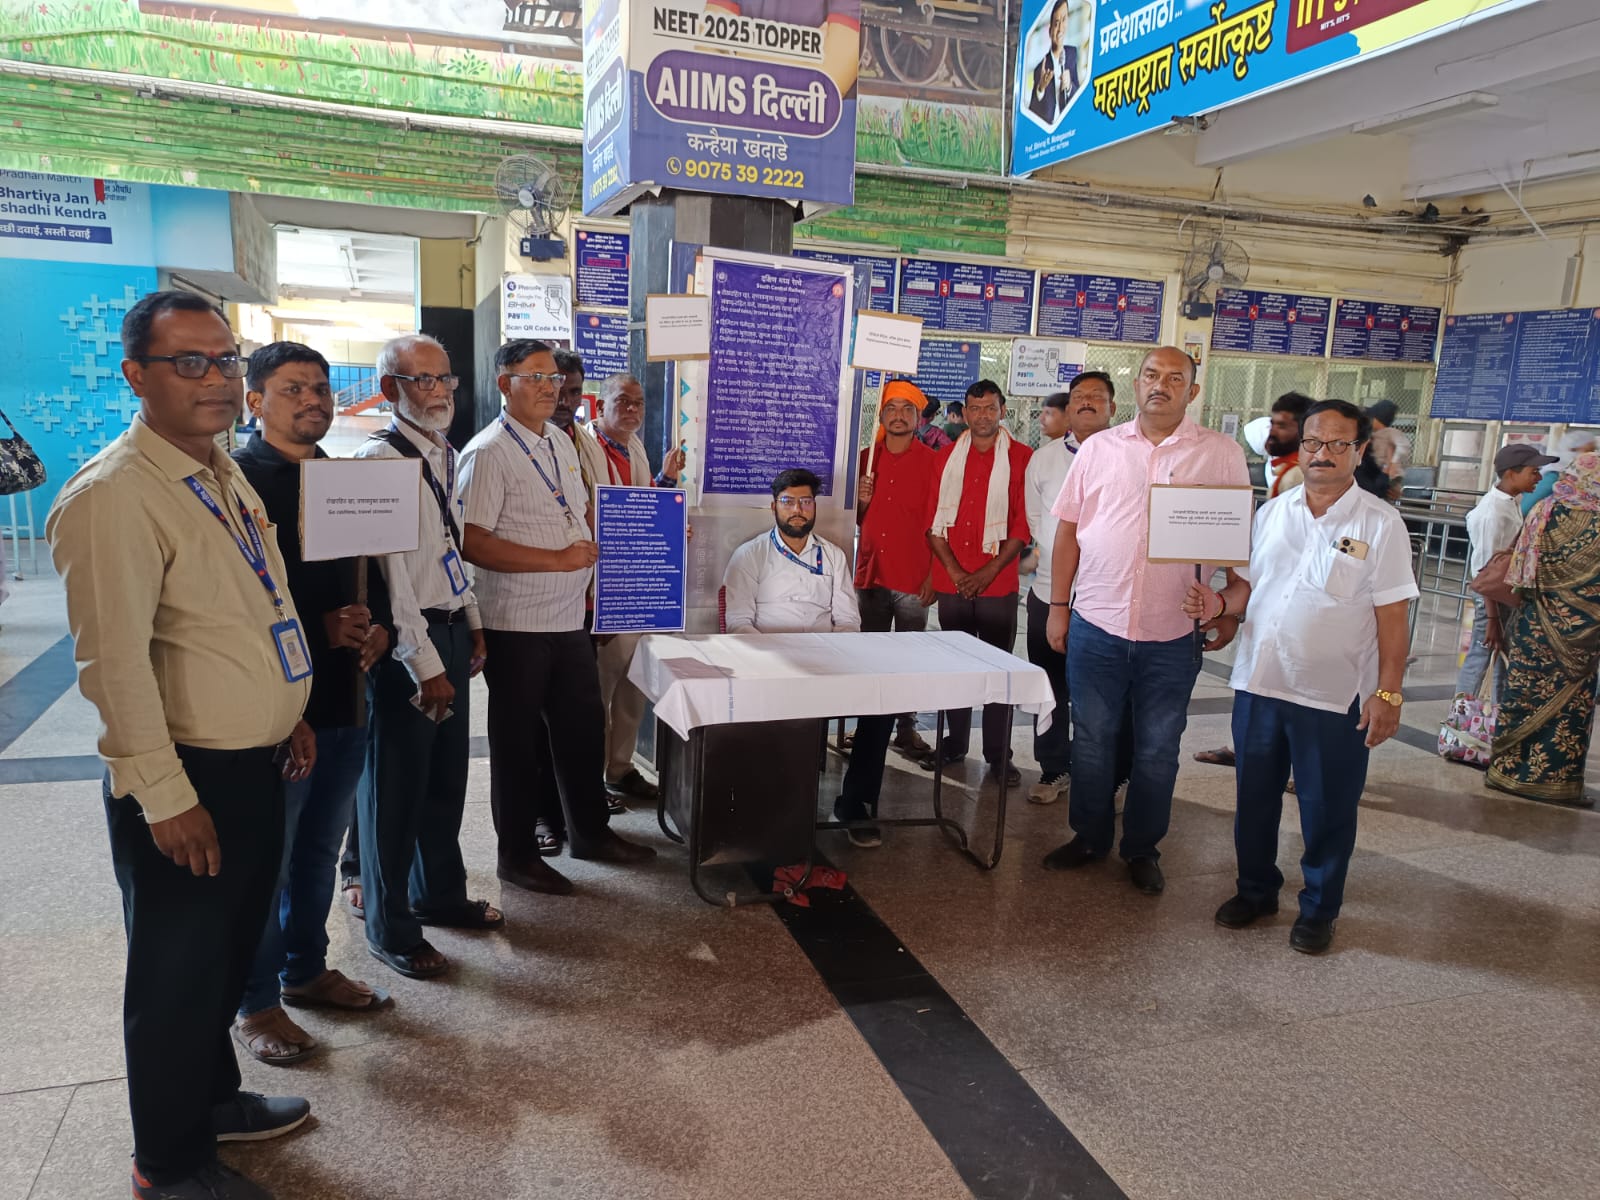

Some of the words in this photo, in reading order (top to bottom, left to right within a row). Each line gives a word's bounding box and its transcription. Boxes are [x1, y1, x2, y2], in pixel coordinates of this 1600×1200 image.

[653, 7, 699, 36] NEET
[704, 15, 750, 44] 2025
[754, 23, 822, 55] TOPPER
[1093, 45, 1174, 119] महाराष्ट्रात
[1178, 1, 1277, 82] सर्वोत्कृष्ट
[655, 67, 747, 116] AIIMS
[752, 74, 828, 124] दिल्ली
[588, 94, 605, 145] AIIMS
[604, 71, 622, 124] दिल्ली
[687, 128, 738, 158] कन्हैया
[743, 133, 789, 163] खंदाडे
[685, 159, 732, 180] 9075
[735, 164, 759, 184] 39
[762, 168, 805, 189] 2222
[0, 187, 61, 205] Bhartiya
[64, 192, 90, 205] Jan
[0, 202, 51, 216] shadhi
[54, 205, 107, 220] Kendra
[0, 222, 15, 233] च्छी
[17, 225, 43, 237] दवाई,
[43, 225, 67, 238] सस्ती
[68, 228, 91, 240] दवाई
[985, 286, 995, 298] 3
[1117, 297, 1127, 309] 4
[1287, 311, 1297, 321] 5
[1401, 320, 1409, 331] 6
